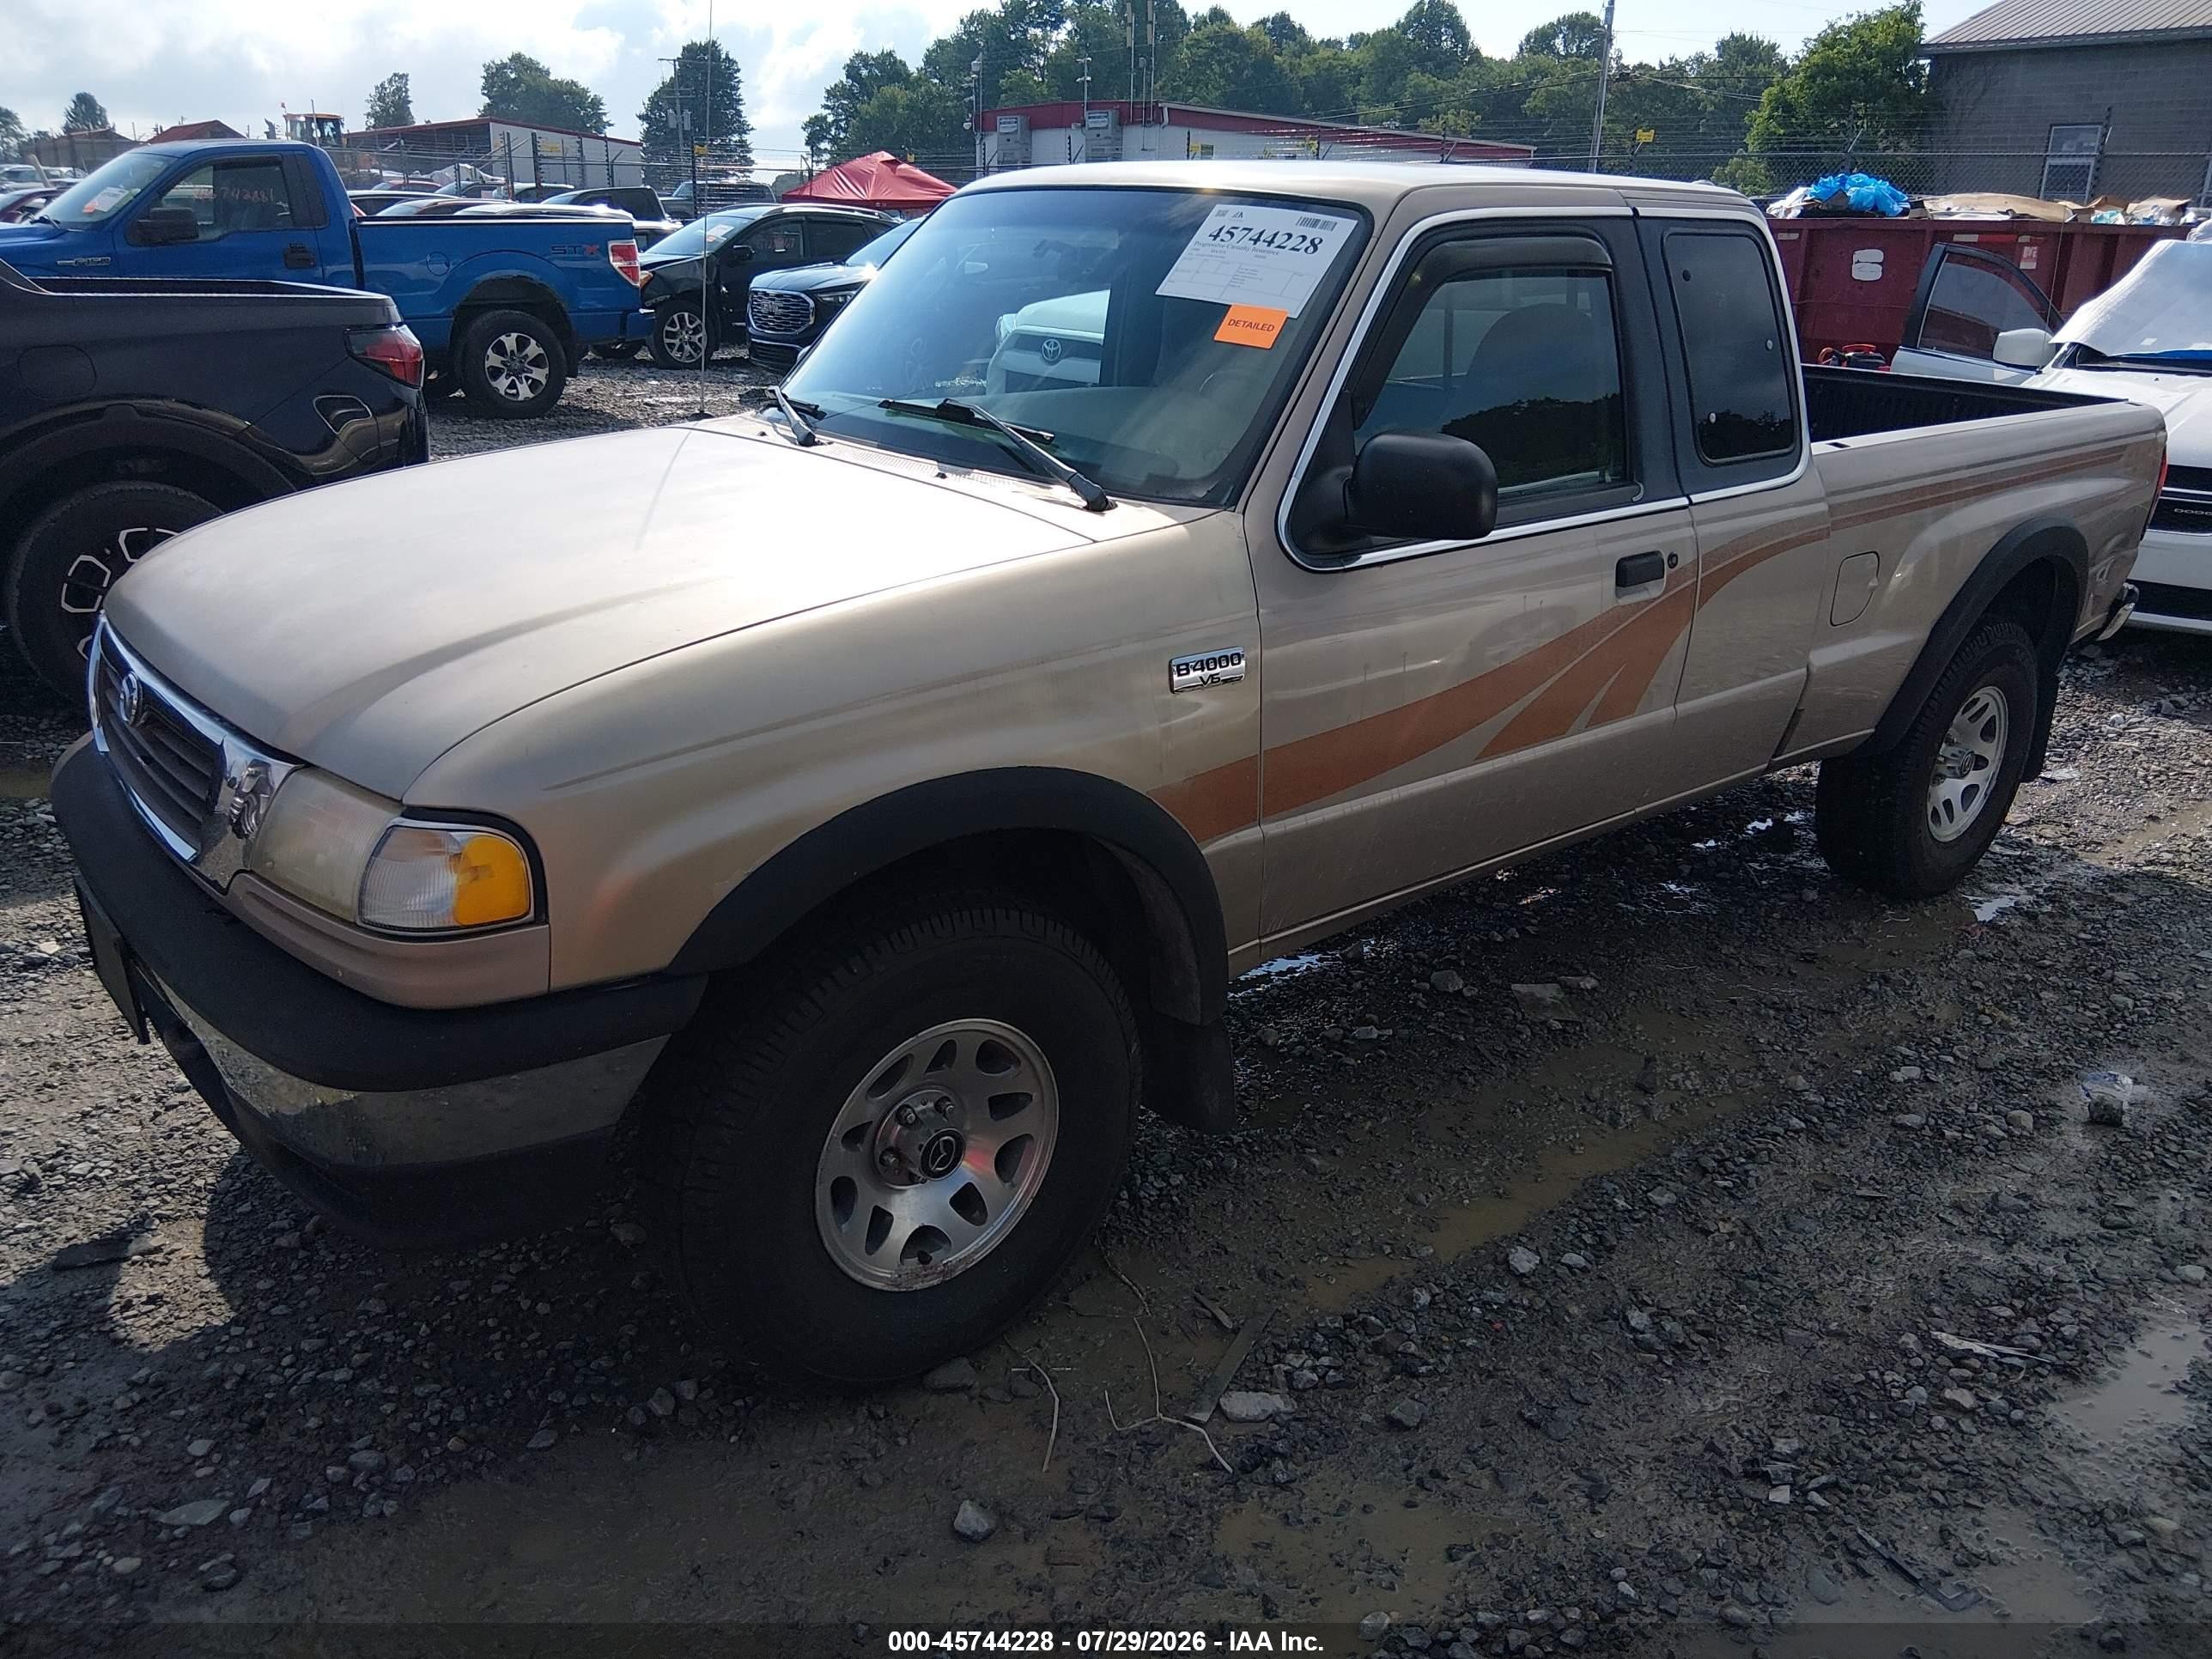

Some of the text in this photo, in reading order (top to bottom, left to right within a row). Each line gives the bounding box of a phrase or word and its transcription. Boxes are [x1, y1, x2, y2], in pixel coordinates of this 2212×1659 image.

[1208, 225, 1323, 255] 45744228
[550, 245, 599, 255] STX
[1228, 319, 1275, 332] DETAILED
[1200, 673, 1221, 686] V6
